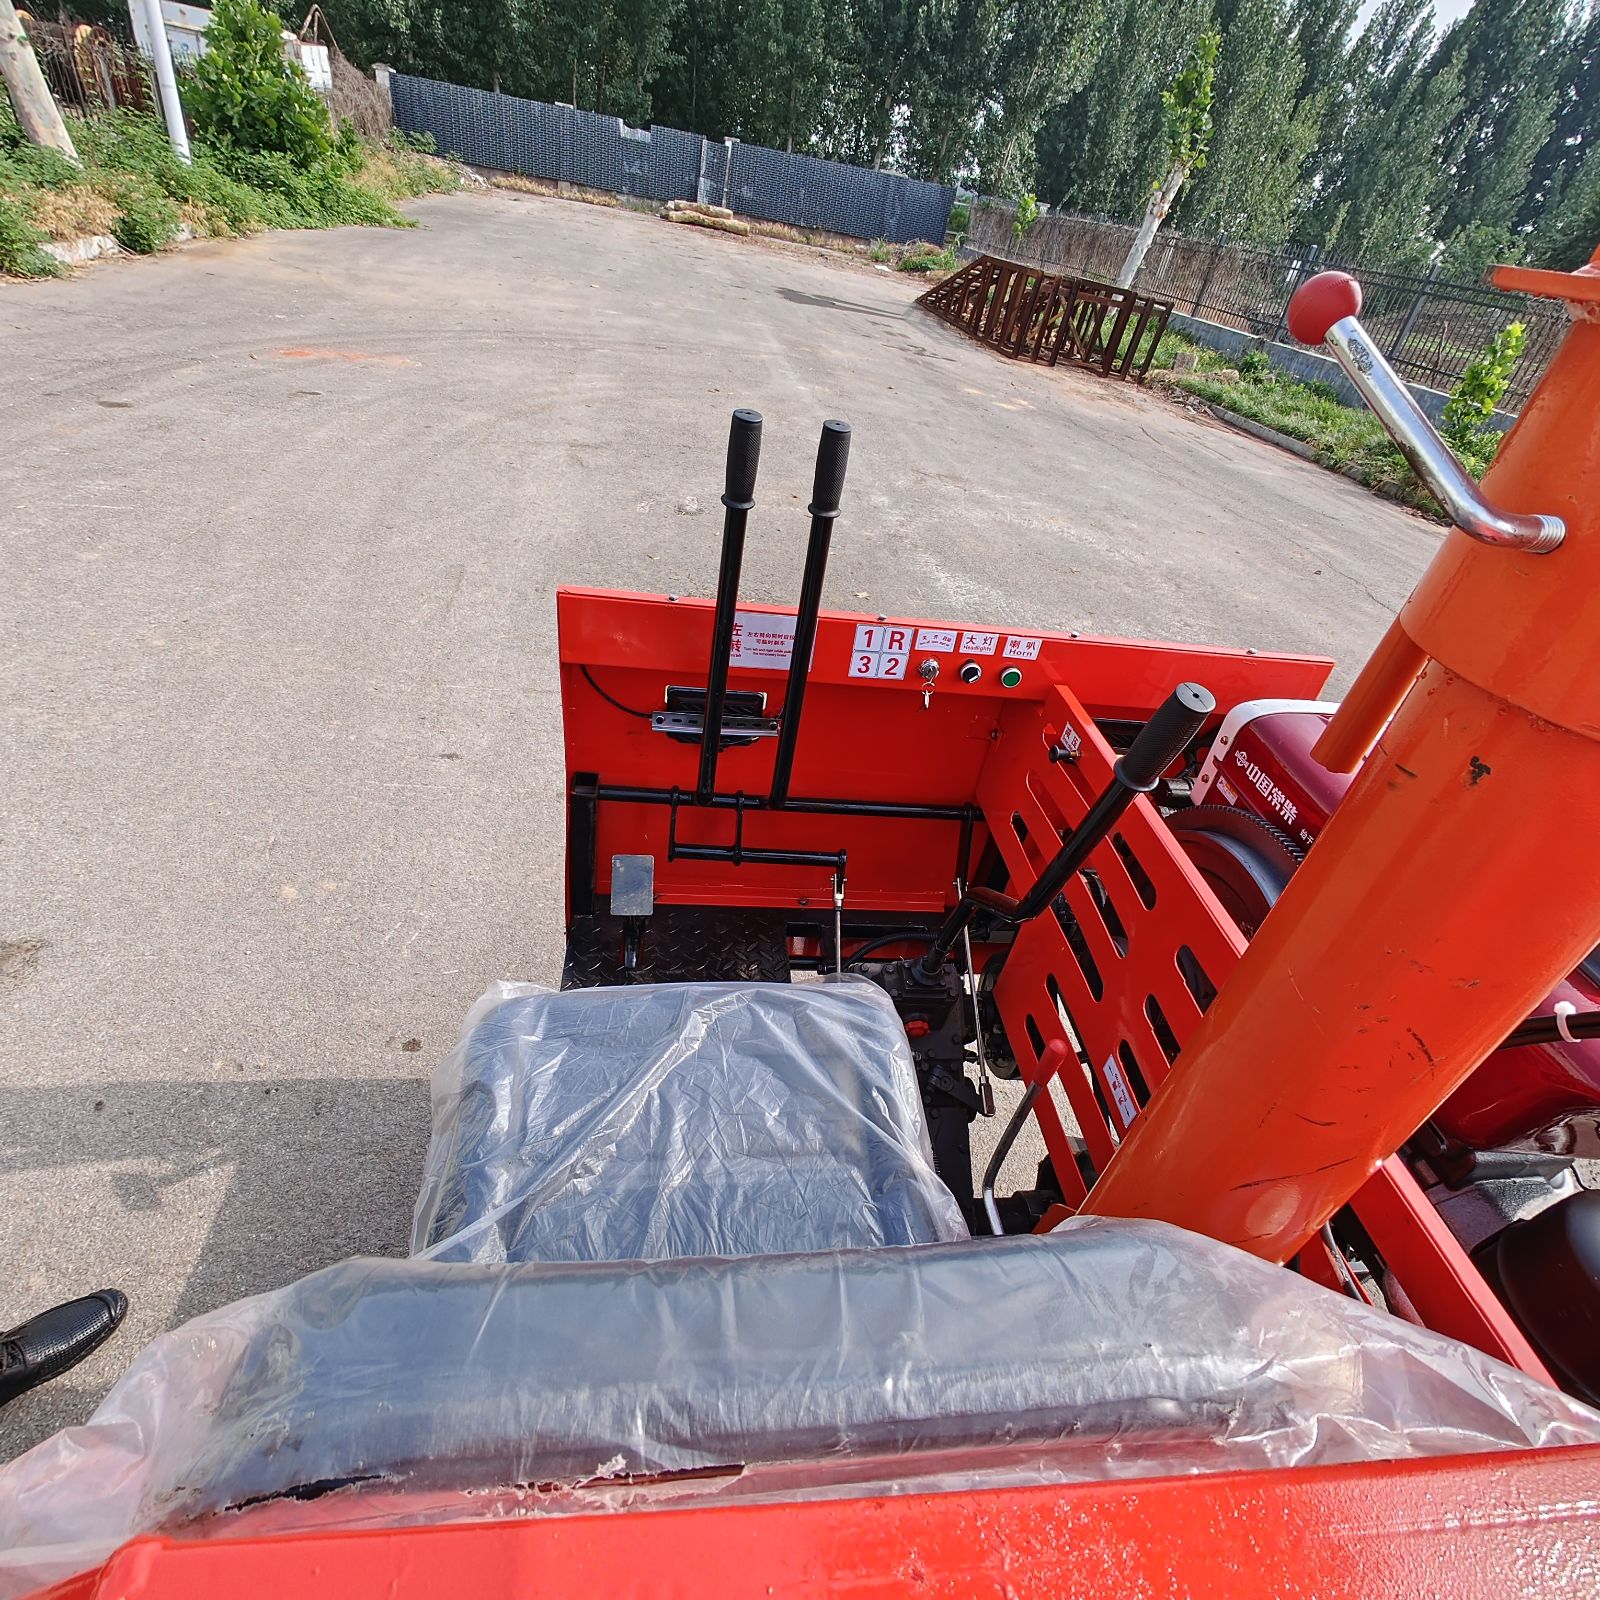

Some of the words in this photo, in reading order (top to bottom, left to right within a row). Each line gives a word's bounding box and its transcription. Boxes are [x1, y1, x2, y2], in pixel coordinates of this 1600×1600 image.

[864, 629, 874, 648] 1
[888, 630, 906, 651] R
[965, 634, 994, 646] 大灯
[1009, 639, 1037, 651] 喇叭
[1008, 649, 1033, 657] Horn
[857, 655, 872, 674] 3
[884, 657, 899, 676] 2
[1246, 763, 1298, 825] 中国常柴
